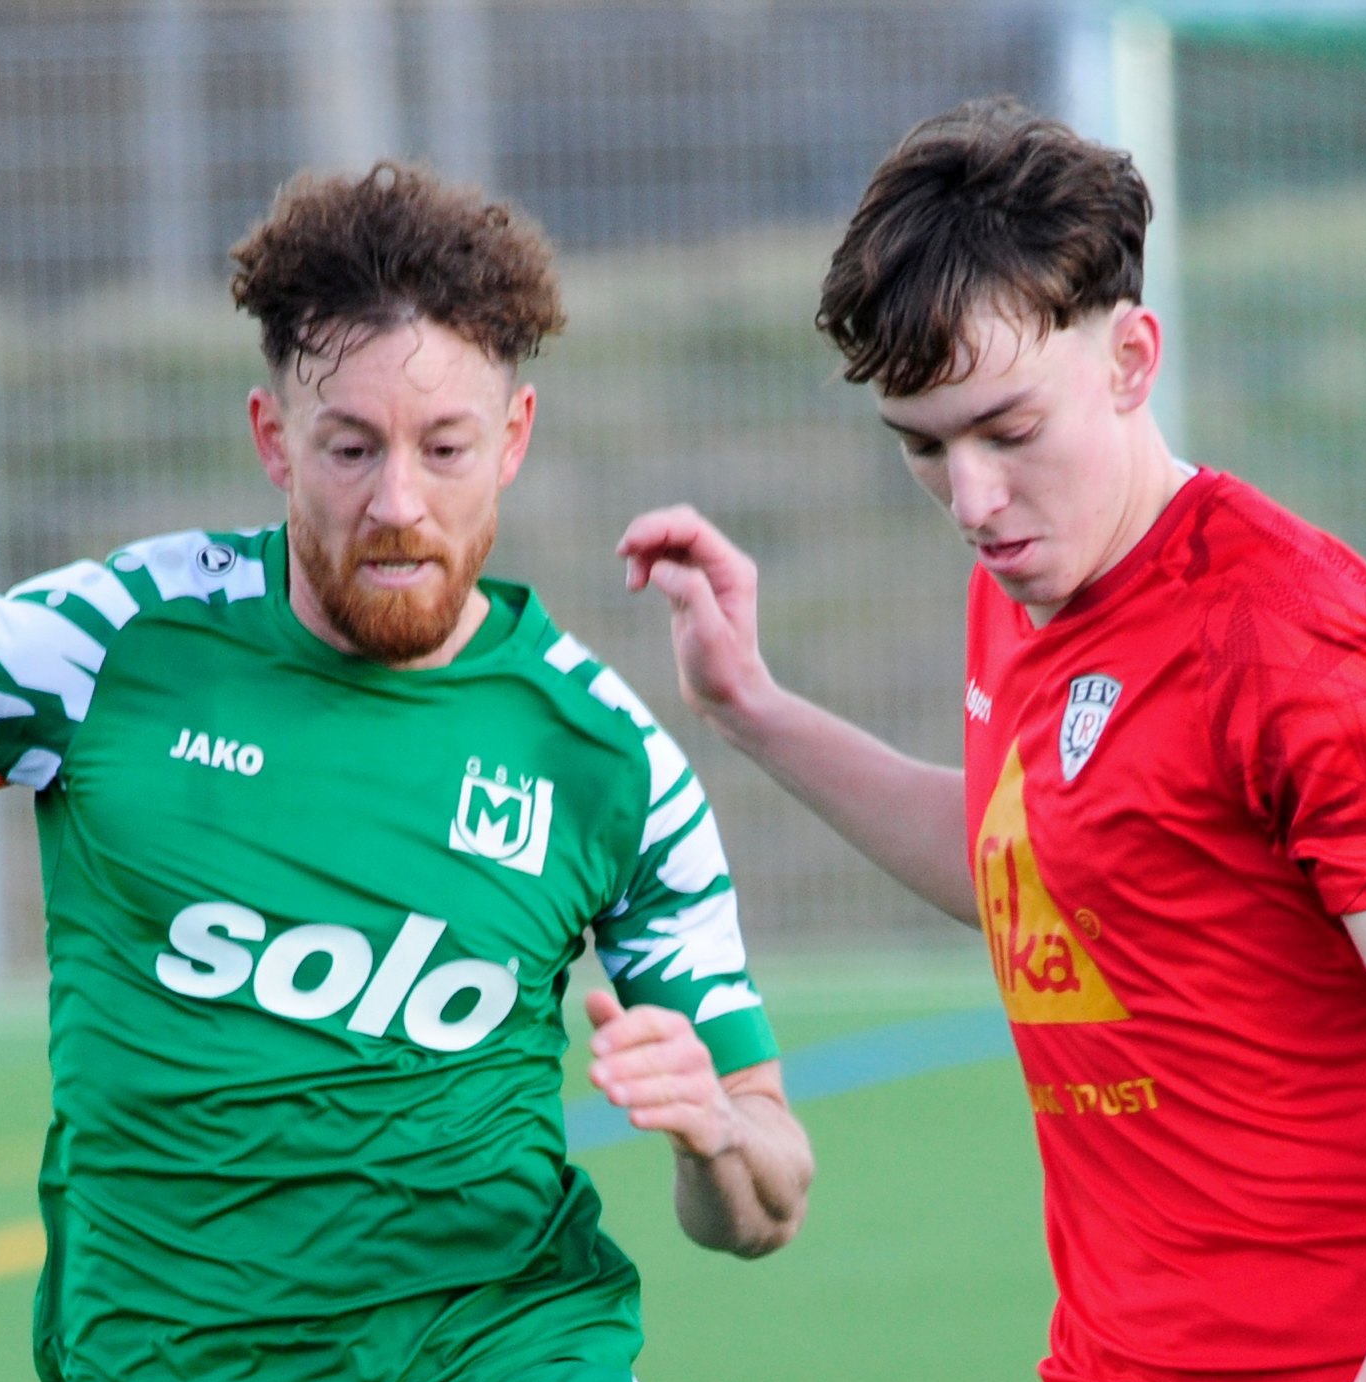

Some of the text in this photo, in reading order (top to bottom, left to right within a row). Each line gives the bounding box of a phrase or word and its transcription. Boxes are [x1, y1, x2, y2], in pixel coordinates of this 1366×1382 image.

[1072, 679, 1117, 706] SSV
[169, 727, 264, 776] JAKO
[155, 901, 519, 1051] solo
